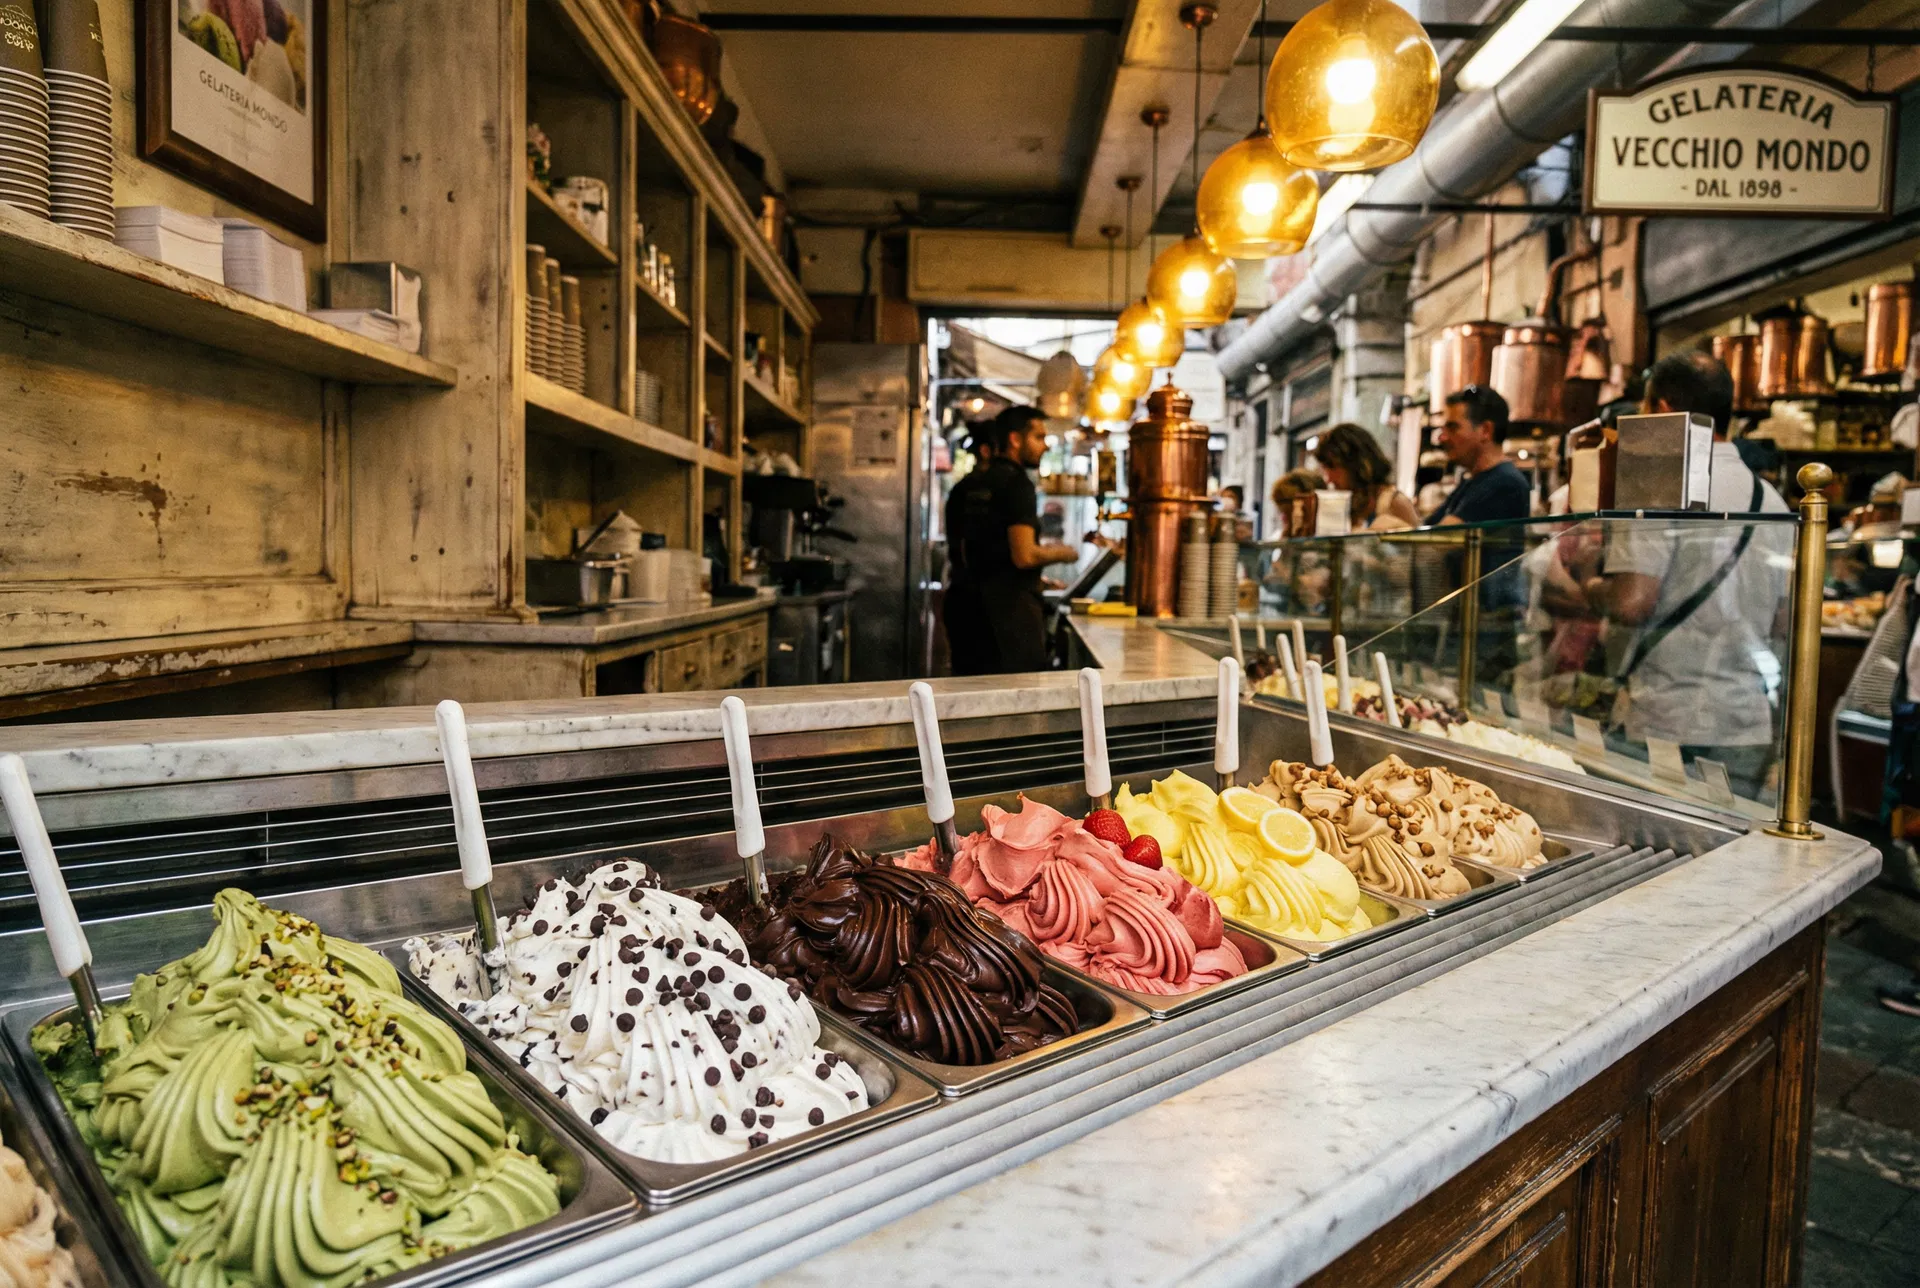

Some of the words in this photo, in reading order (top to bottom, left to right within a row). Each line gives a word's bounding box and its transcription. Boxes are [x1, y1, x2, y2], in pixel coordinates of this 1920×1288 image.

[199, 69, 251, 110] GELATERIA
[252, 101, 288, 134] MONDO
[1648, 83, 1836, 130] GELATERIA
[1612, 136, 1743, 169] VECCHIO
[1756, 138, 1871, 173] MONDO
[1695, 178, 1731, 198] DAL
[1738, 178, 1783, 199] 1898
